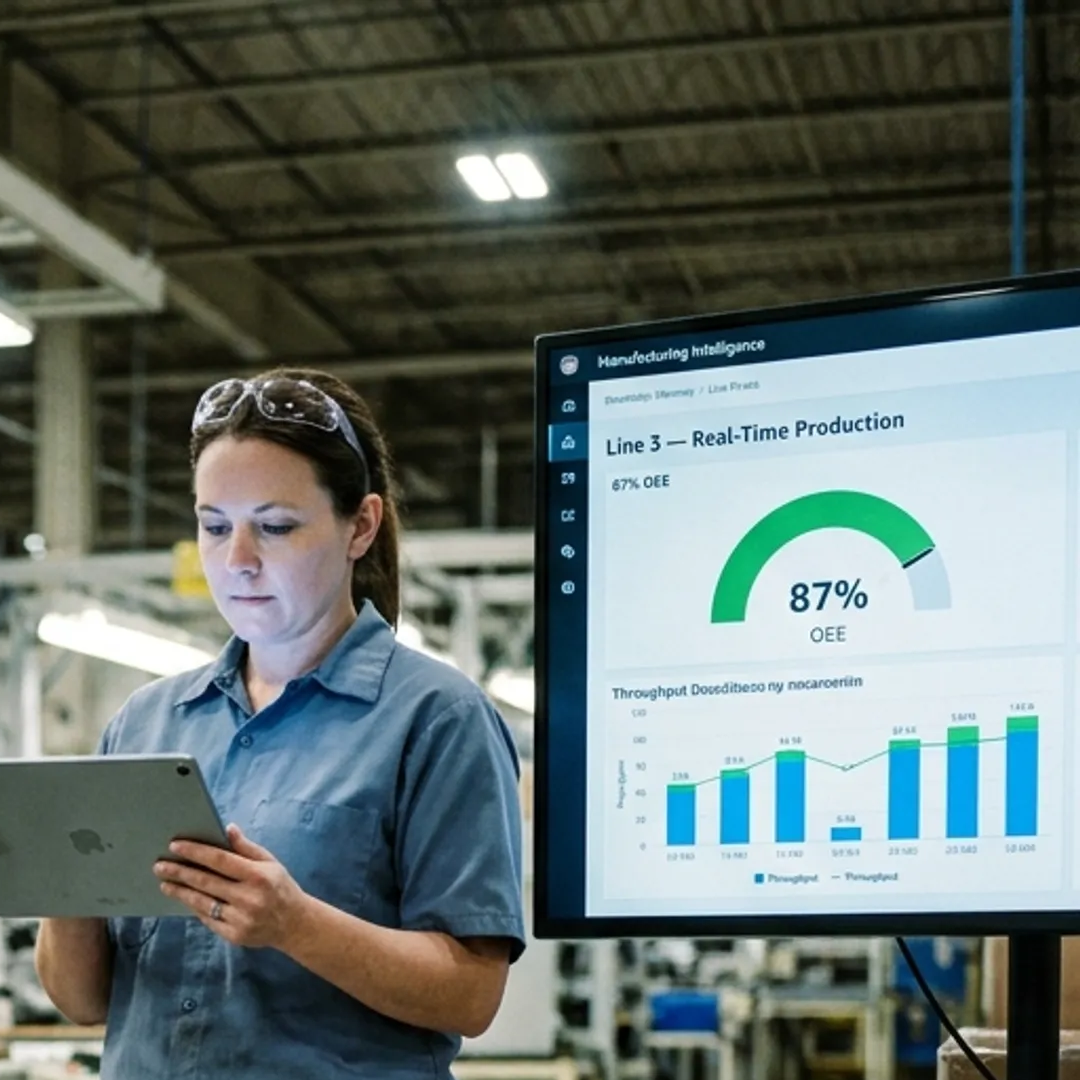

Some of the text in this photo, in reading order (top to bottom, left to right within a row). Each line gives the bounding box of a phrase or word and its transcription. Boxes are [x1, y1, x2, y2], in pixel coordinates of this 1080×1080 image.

[606, 436, 644, 456] Line
[650, 435, 662, 452] 3
[692, 423, 789, 448] Real-Time
[795, 411, 905, 438] Production
[643, 475, 670, 489] OEE
[789, 578, 869, 613] 87%
[810, 625, 847, 643] OEE
[612, 683, 687, 701] Throughput
